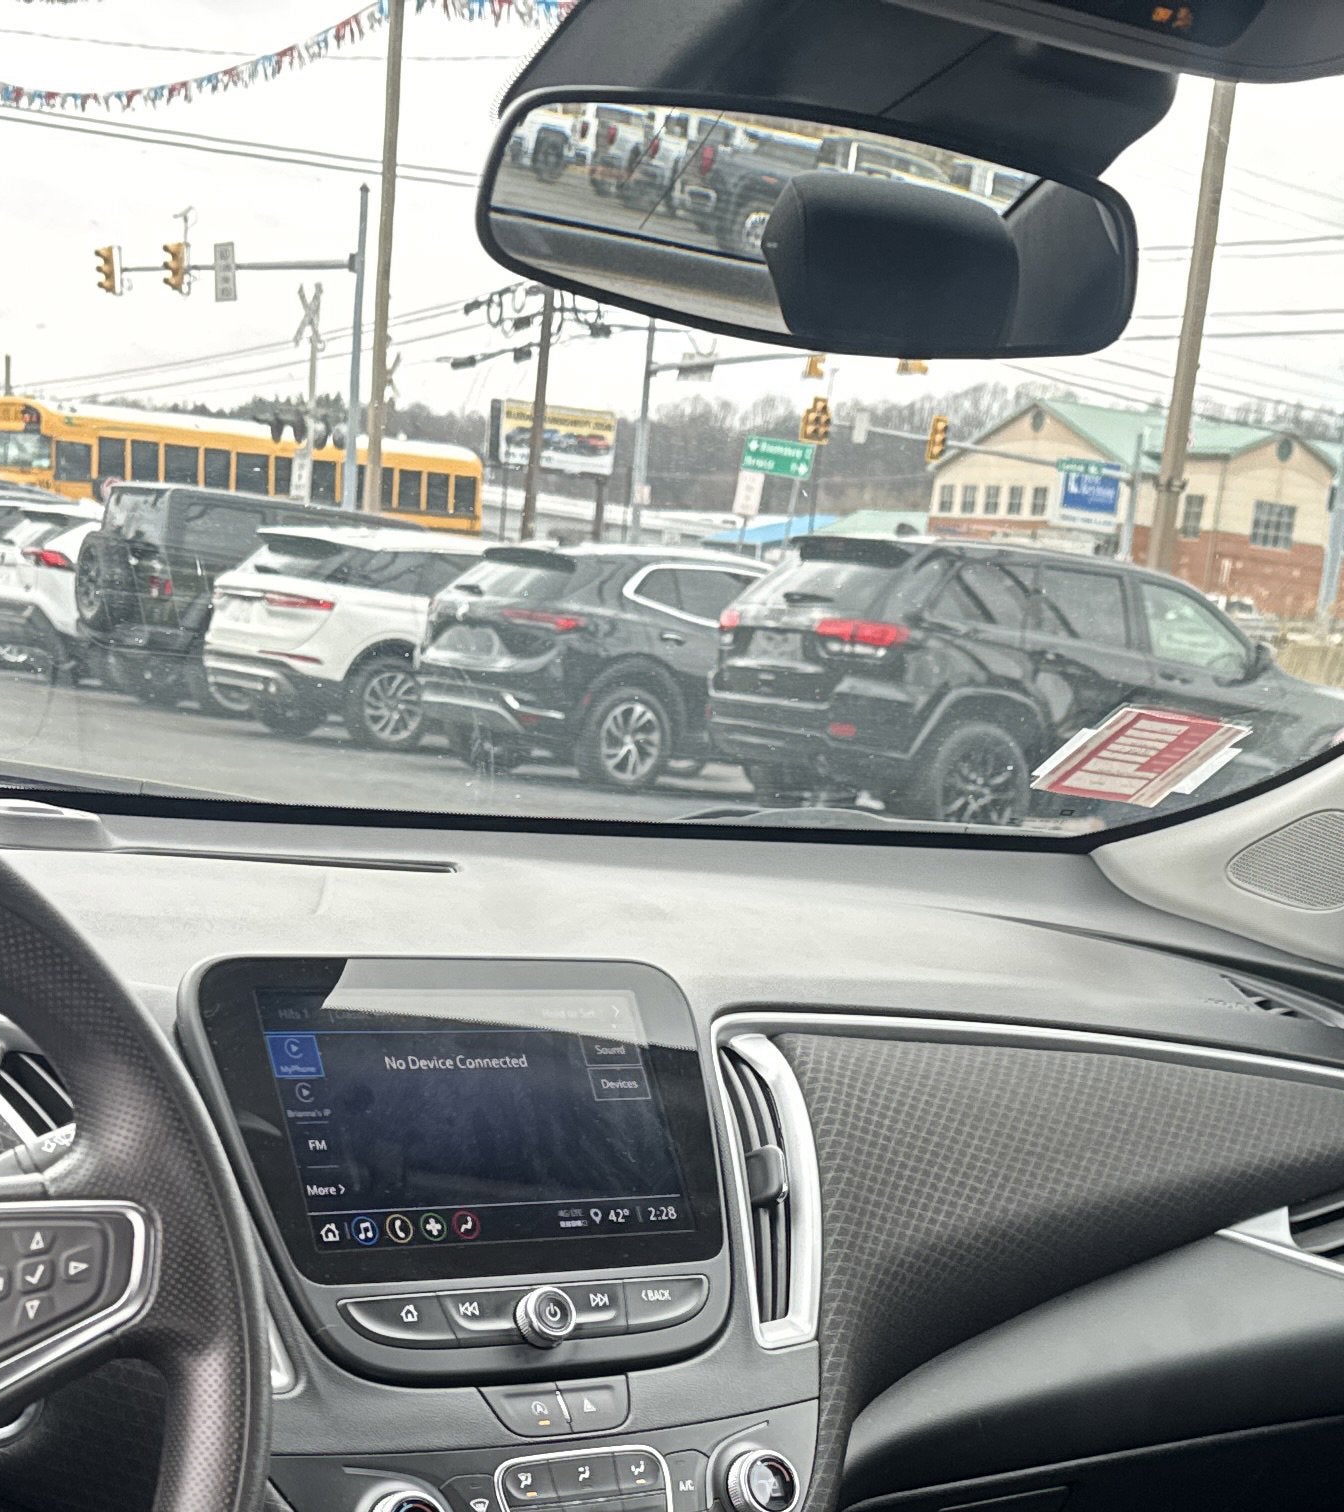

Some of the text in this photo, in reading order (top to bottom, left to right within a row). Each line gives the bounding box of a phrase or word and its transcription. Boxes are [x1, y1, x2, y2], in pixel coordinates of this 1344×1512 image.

[594, 1043, 626, 1056] Sound
[384, 1053, 528, 1070] No Device Connected
[600, 1078, 639, 1090] Devices
[307, 1139, 328, 1151] FM
[306, 1184, 338, 1197] More
[647, 1206, 678, 1221] 2:28
[647, 1289, 672, 1301] BACK
[679, 1480, 695, 1492] A/C
